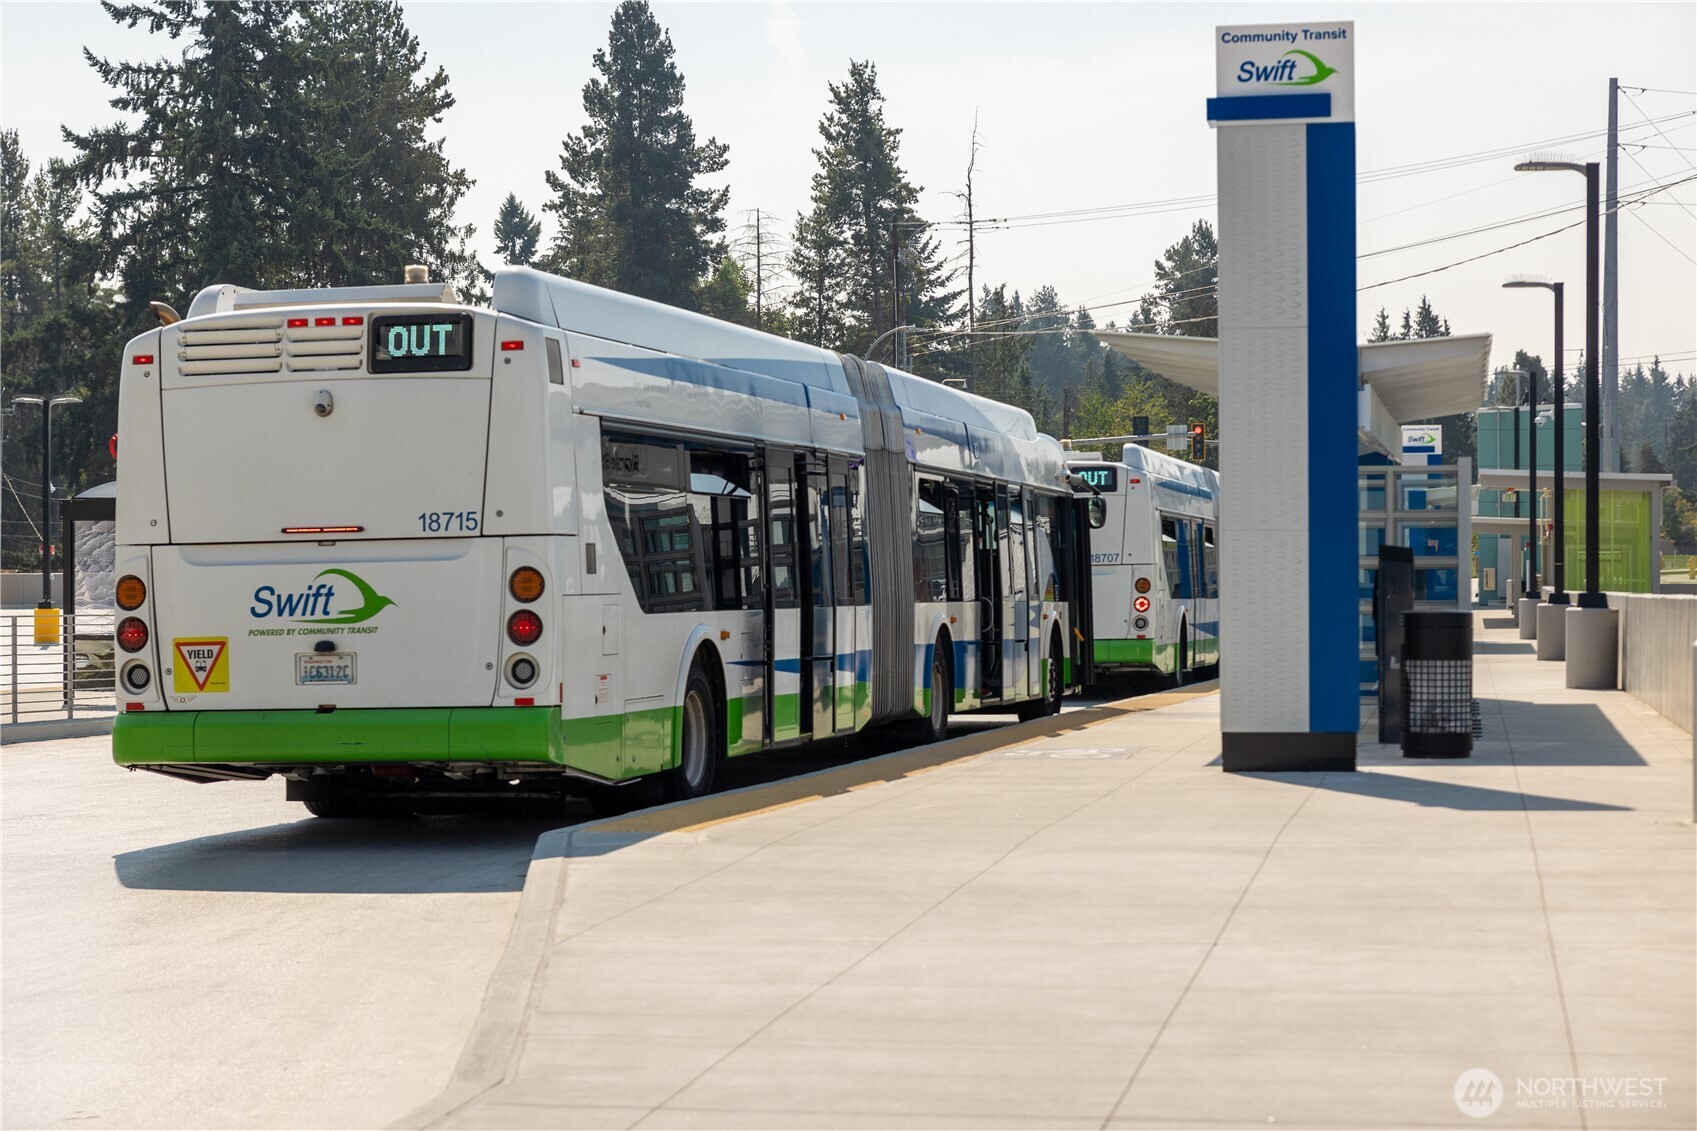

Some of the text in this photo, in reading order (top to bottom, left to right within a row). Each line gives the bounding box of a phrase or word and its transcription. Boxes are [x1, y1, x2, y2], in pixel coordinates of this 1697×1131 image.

[1221, 27, 1347, 44] Community Transit
[1237, 60, 1297, 83] Swift
[388, 324, 453, 357] OUT
[1407, 435, 1426, 443] Swift
[418, 511, 479, 533] 18715
[1090, 553, 1120, 563] 18707
[250, 584, 335, 618] Swift
[248, 626, 379, 637] POWERED BY COMMUNITY TRANSIT
[187, 649, 214, 660] YIELD
[309, 665, 350, 679] C6312C
